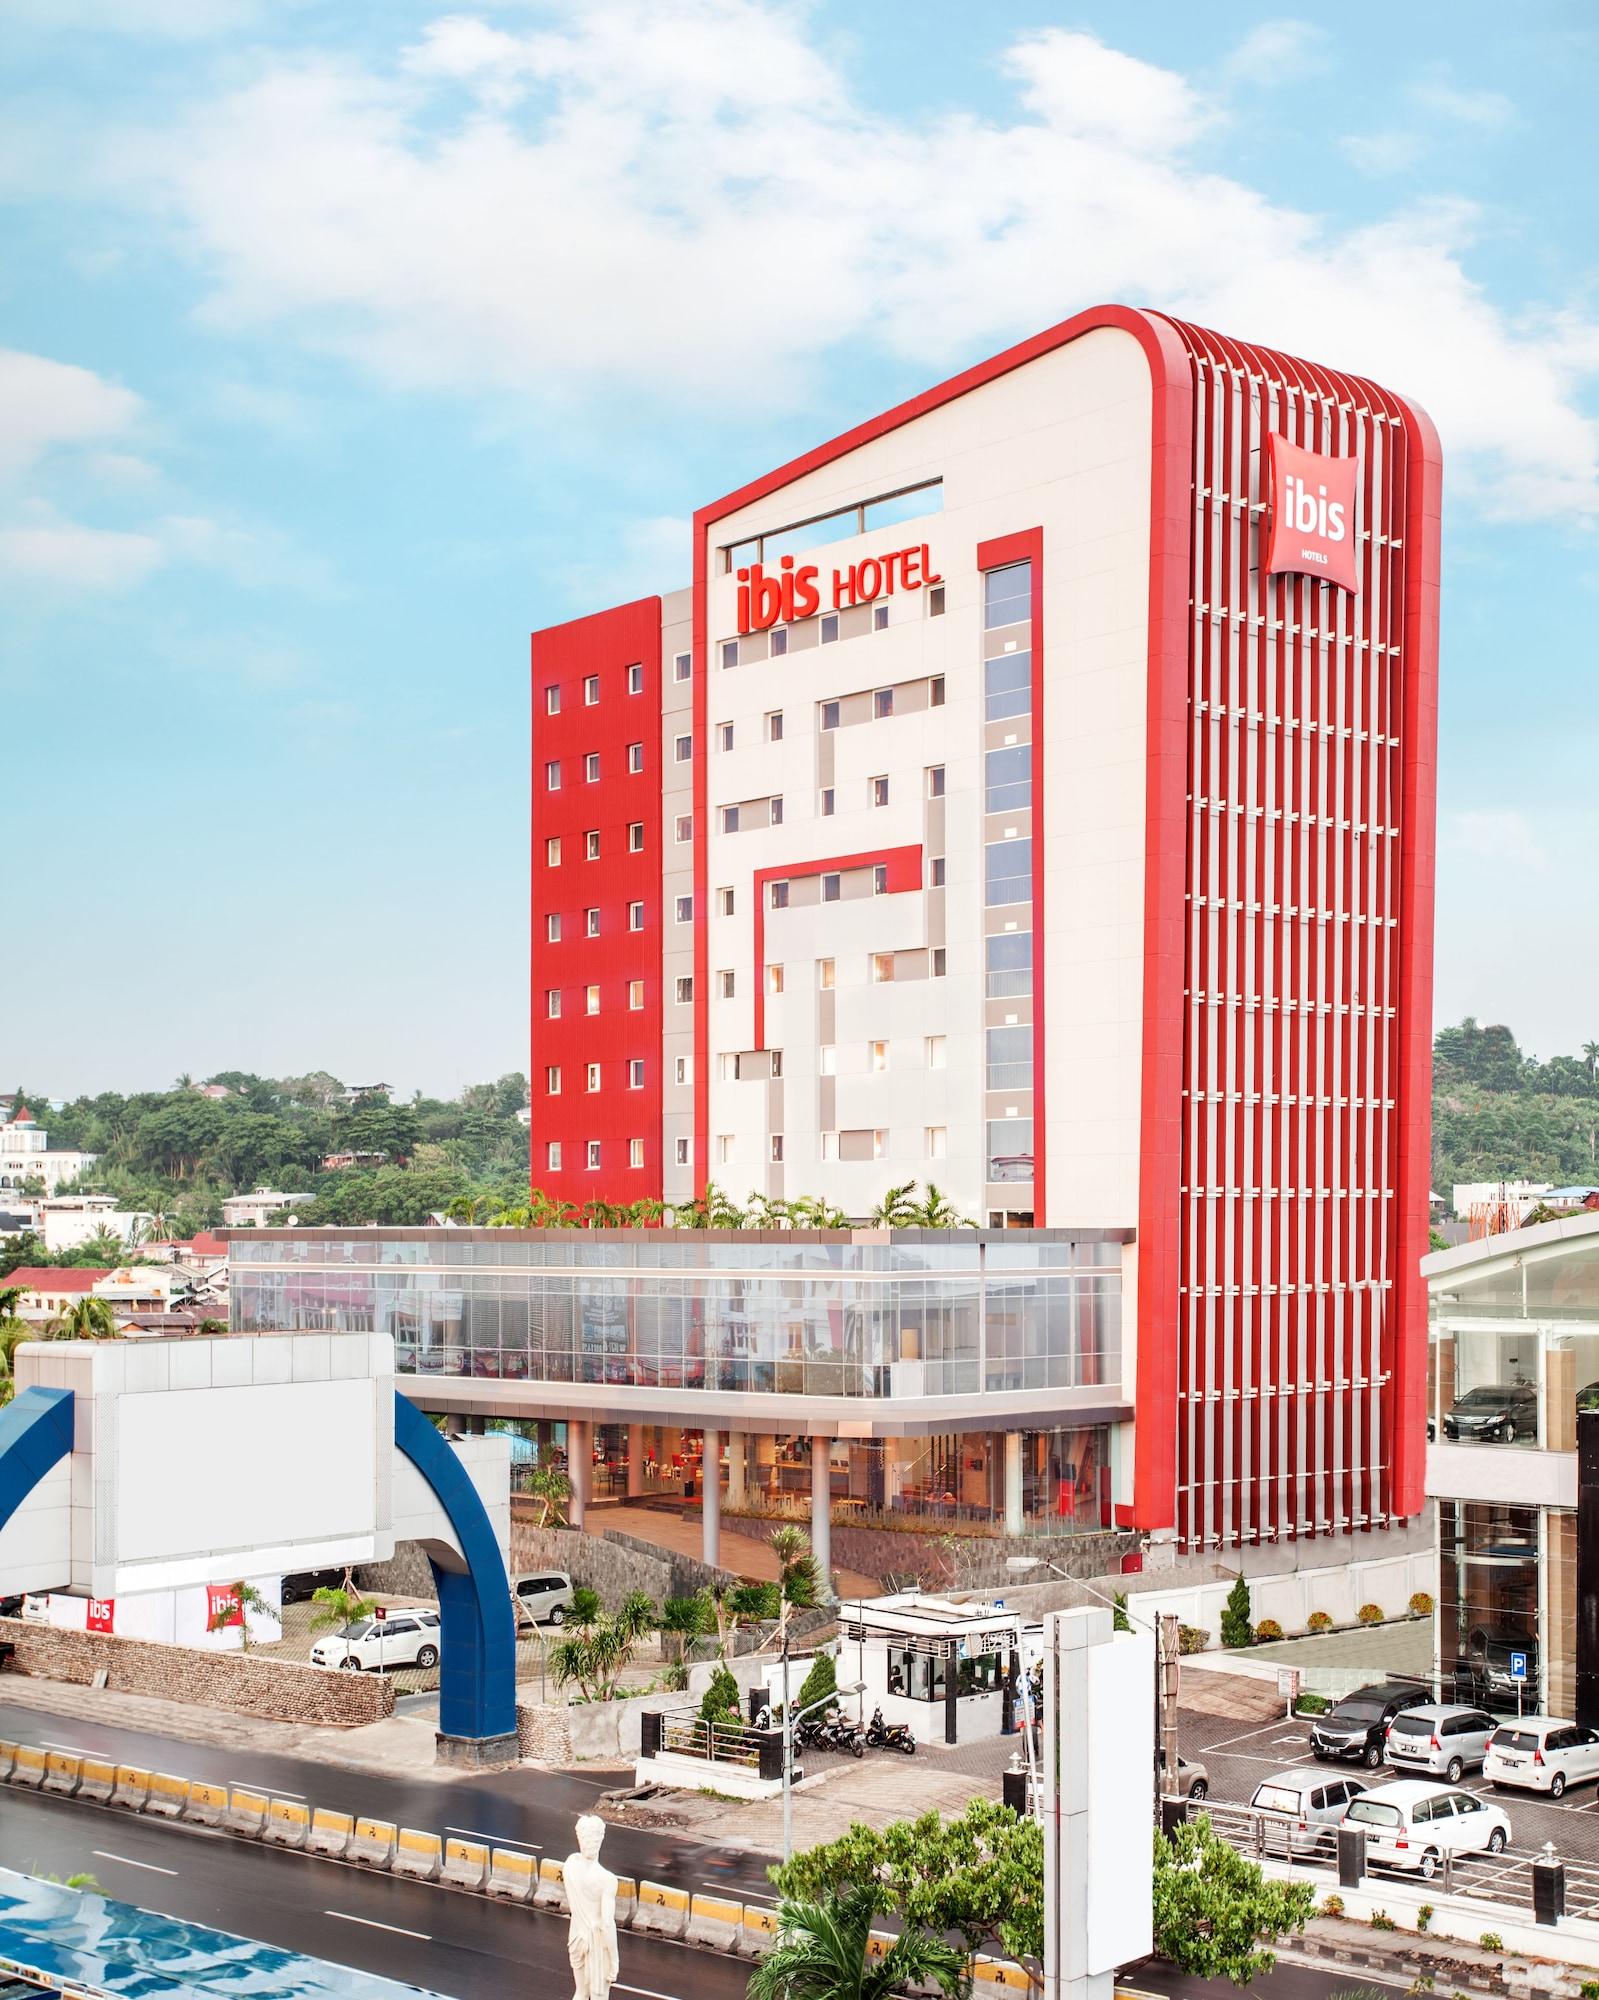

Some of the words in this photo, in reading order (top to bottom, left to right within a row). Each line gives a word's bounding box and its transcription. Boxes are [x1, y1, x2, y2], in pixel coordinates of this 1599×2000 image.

[1285, 475, 1345, 541] ibis
[1301, 549, 1328, 565] HOTELS
[737, 555, 820, 633] ibis
[833, 543, 941, 609] HOTEL
[1513, 1657, 1524, 1672] P
